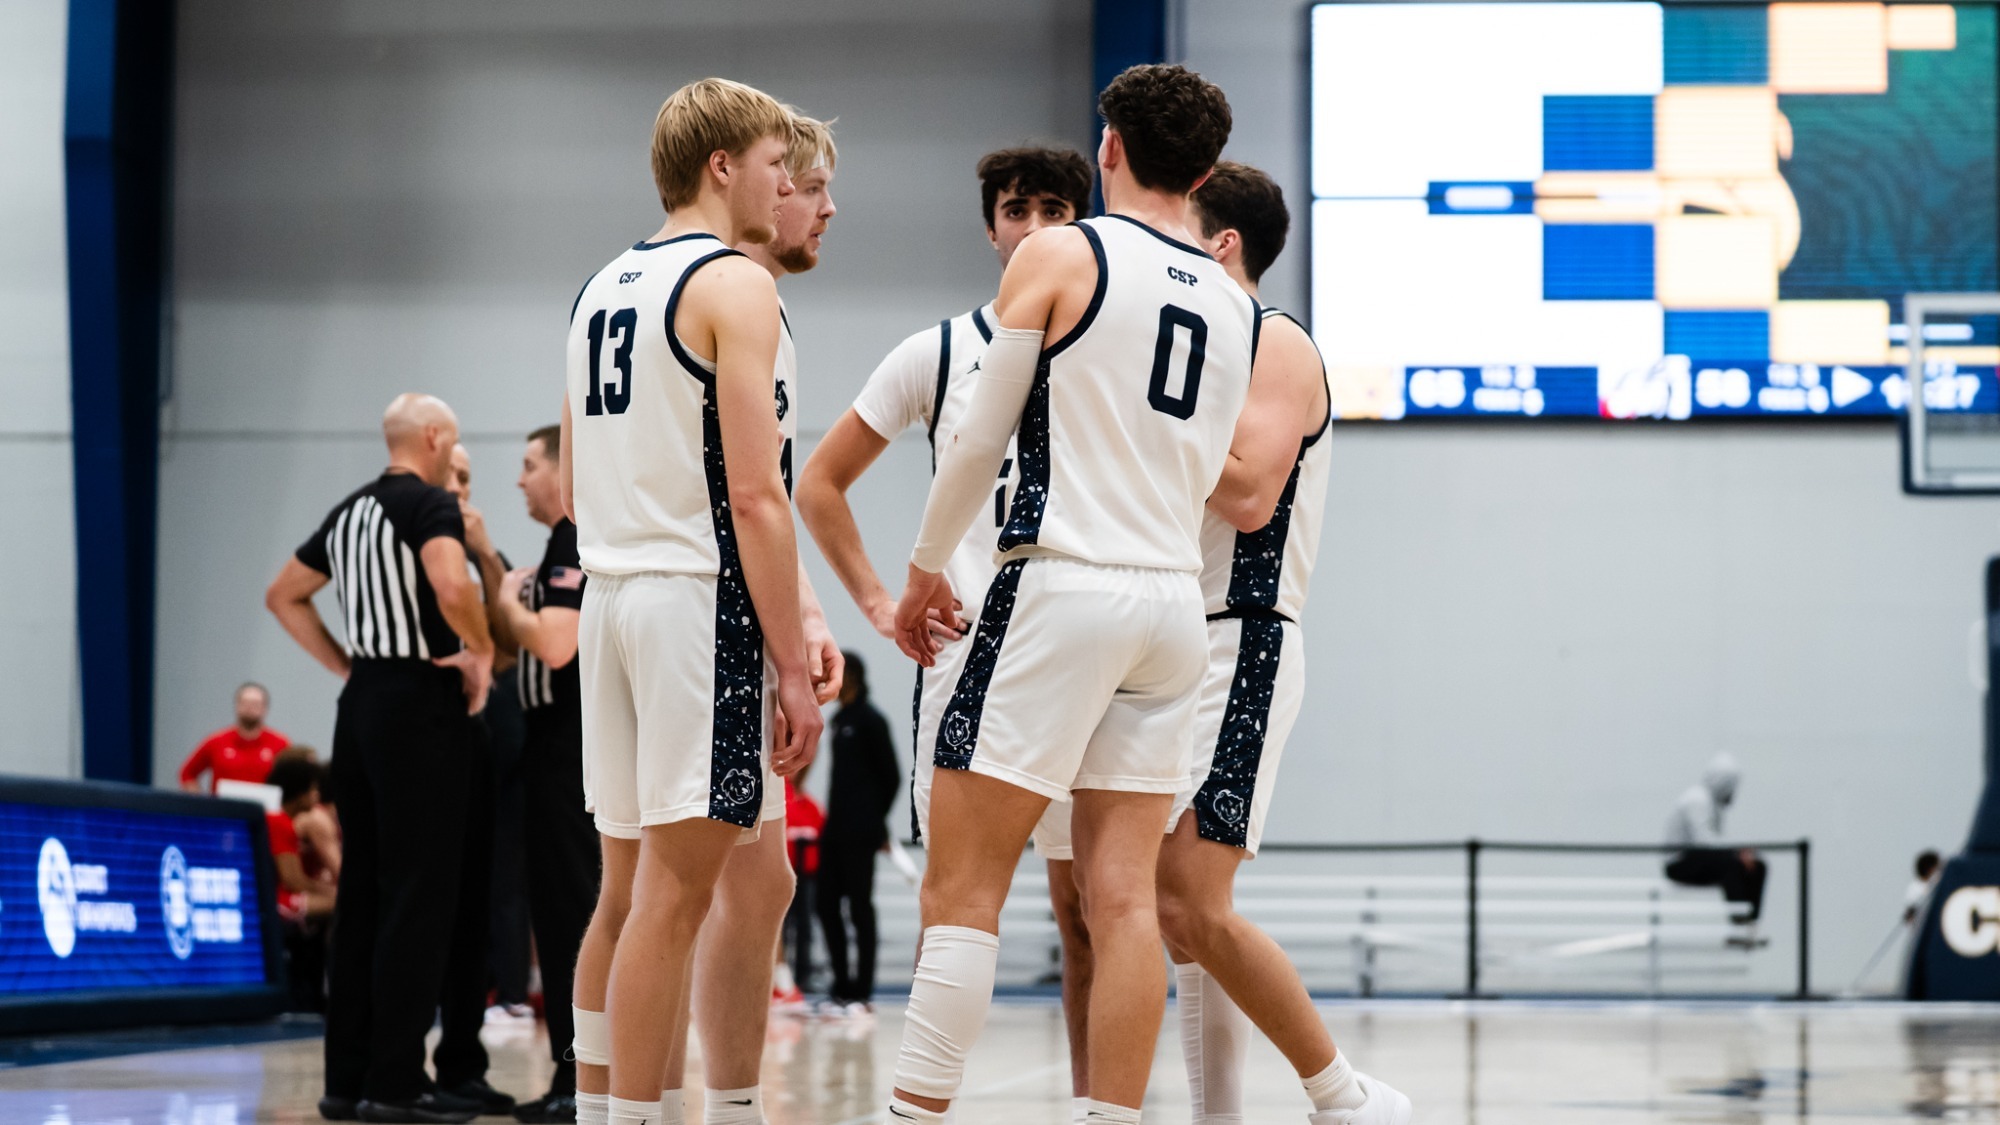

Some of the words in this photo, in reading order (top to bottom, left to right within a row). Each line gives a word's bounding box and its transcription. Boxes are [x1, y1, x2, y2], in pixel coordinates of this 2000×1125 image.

[618, 271, 643, 284] CSP
[1167, 265, 1198, 287] CSP
[585, 307, 638, 416] 13
[1147, 303, 1208, 421] 0
